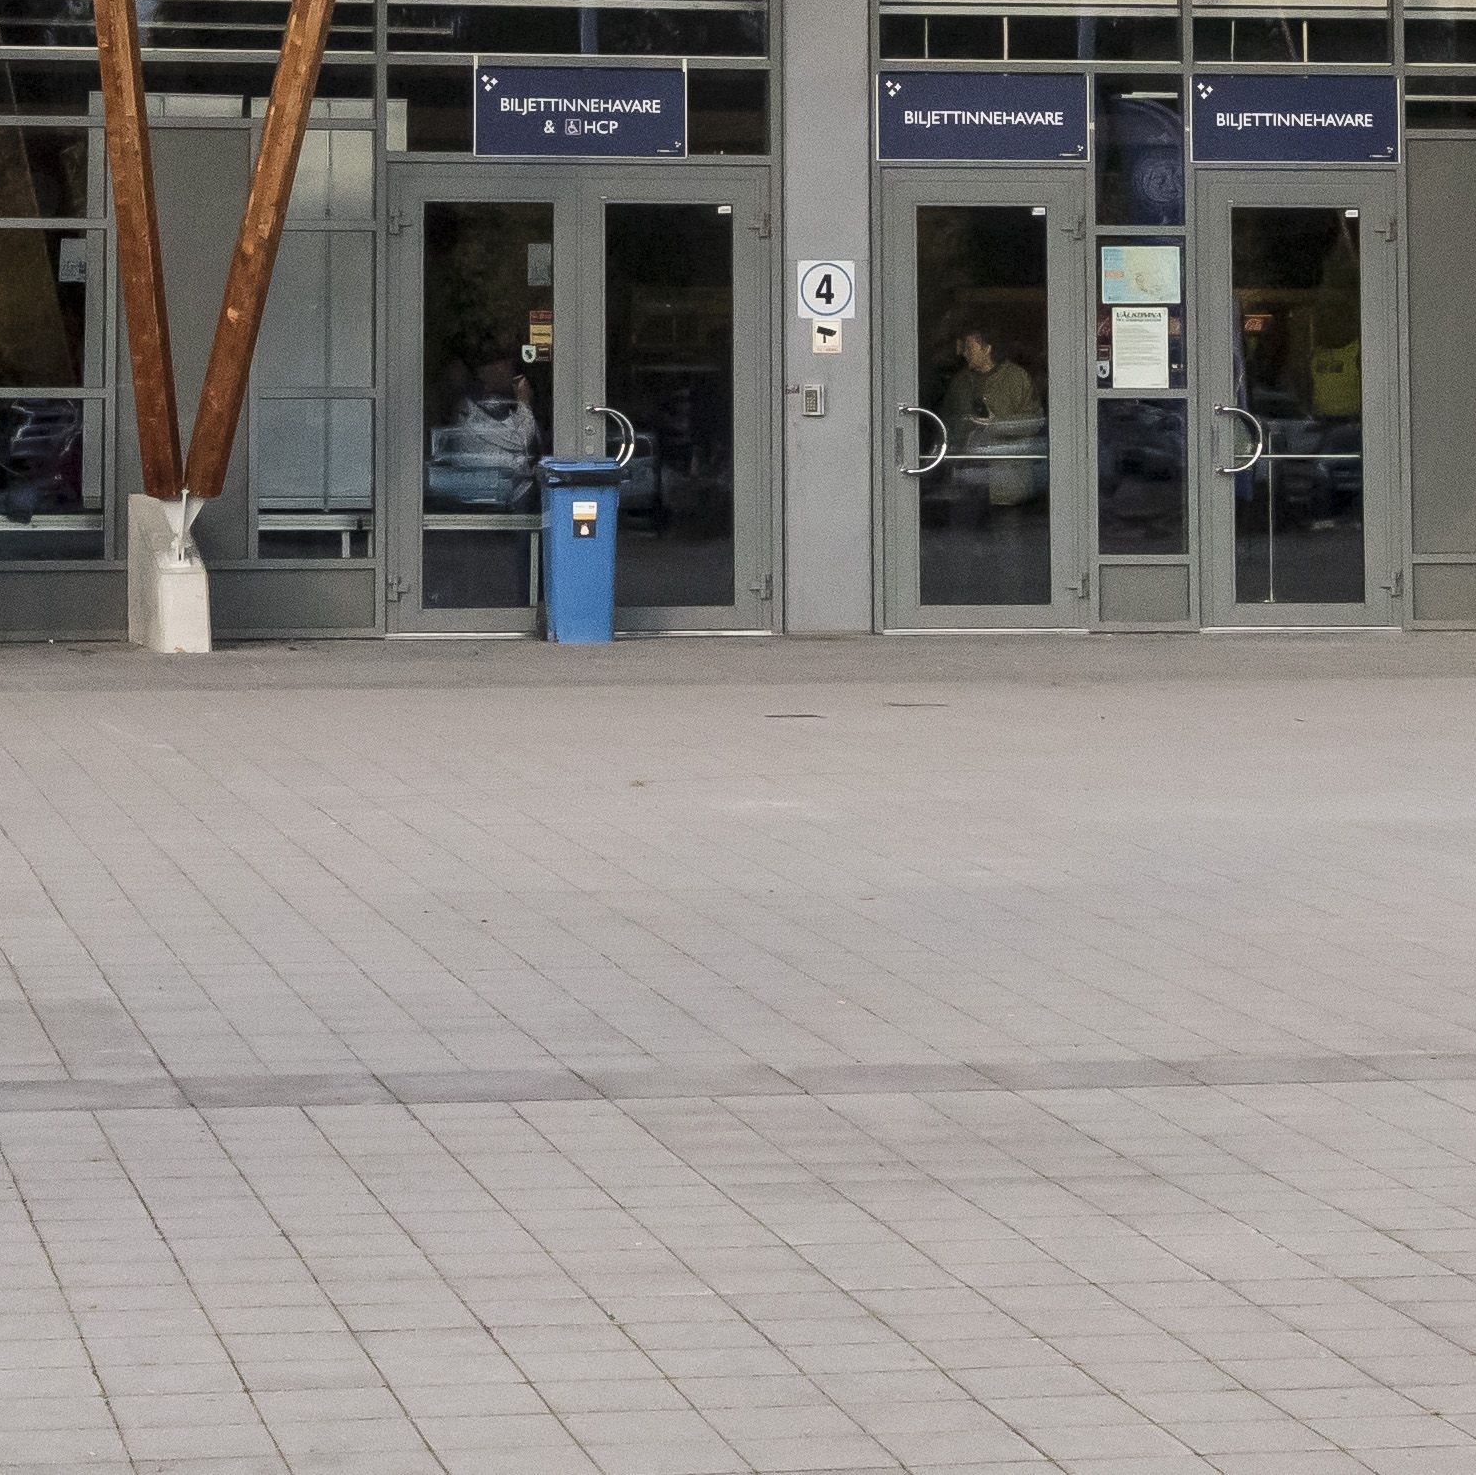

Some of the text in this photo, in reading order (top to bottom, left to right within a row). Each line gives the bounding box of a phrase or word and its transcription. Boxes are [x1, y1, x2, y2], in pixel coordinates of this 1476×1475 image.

[500, 97, 661, 115] BILJETTINNEHAVARE
[543, 119, 619, 134] & HCP
[904, 110, 1064, 129] BILJETTINNEHAVARE
[1216, 112, 1373, 130] BILJETTINNEHAVARE
[815, 274, 835, 305] 4
